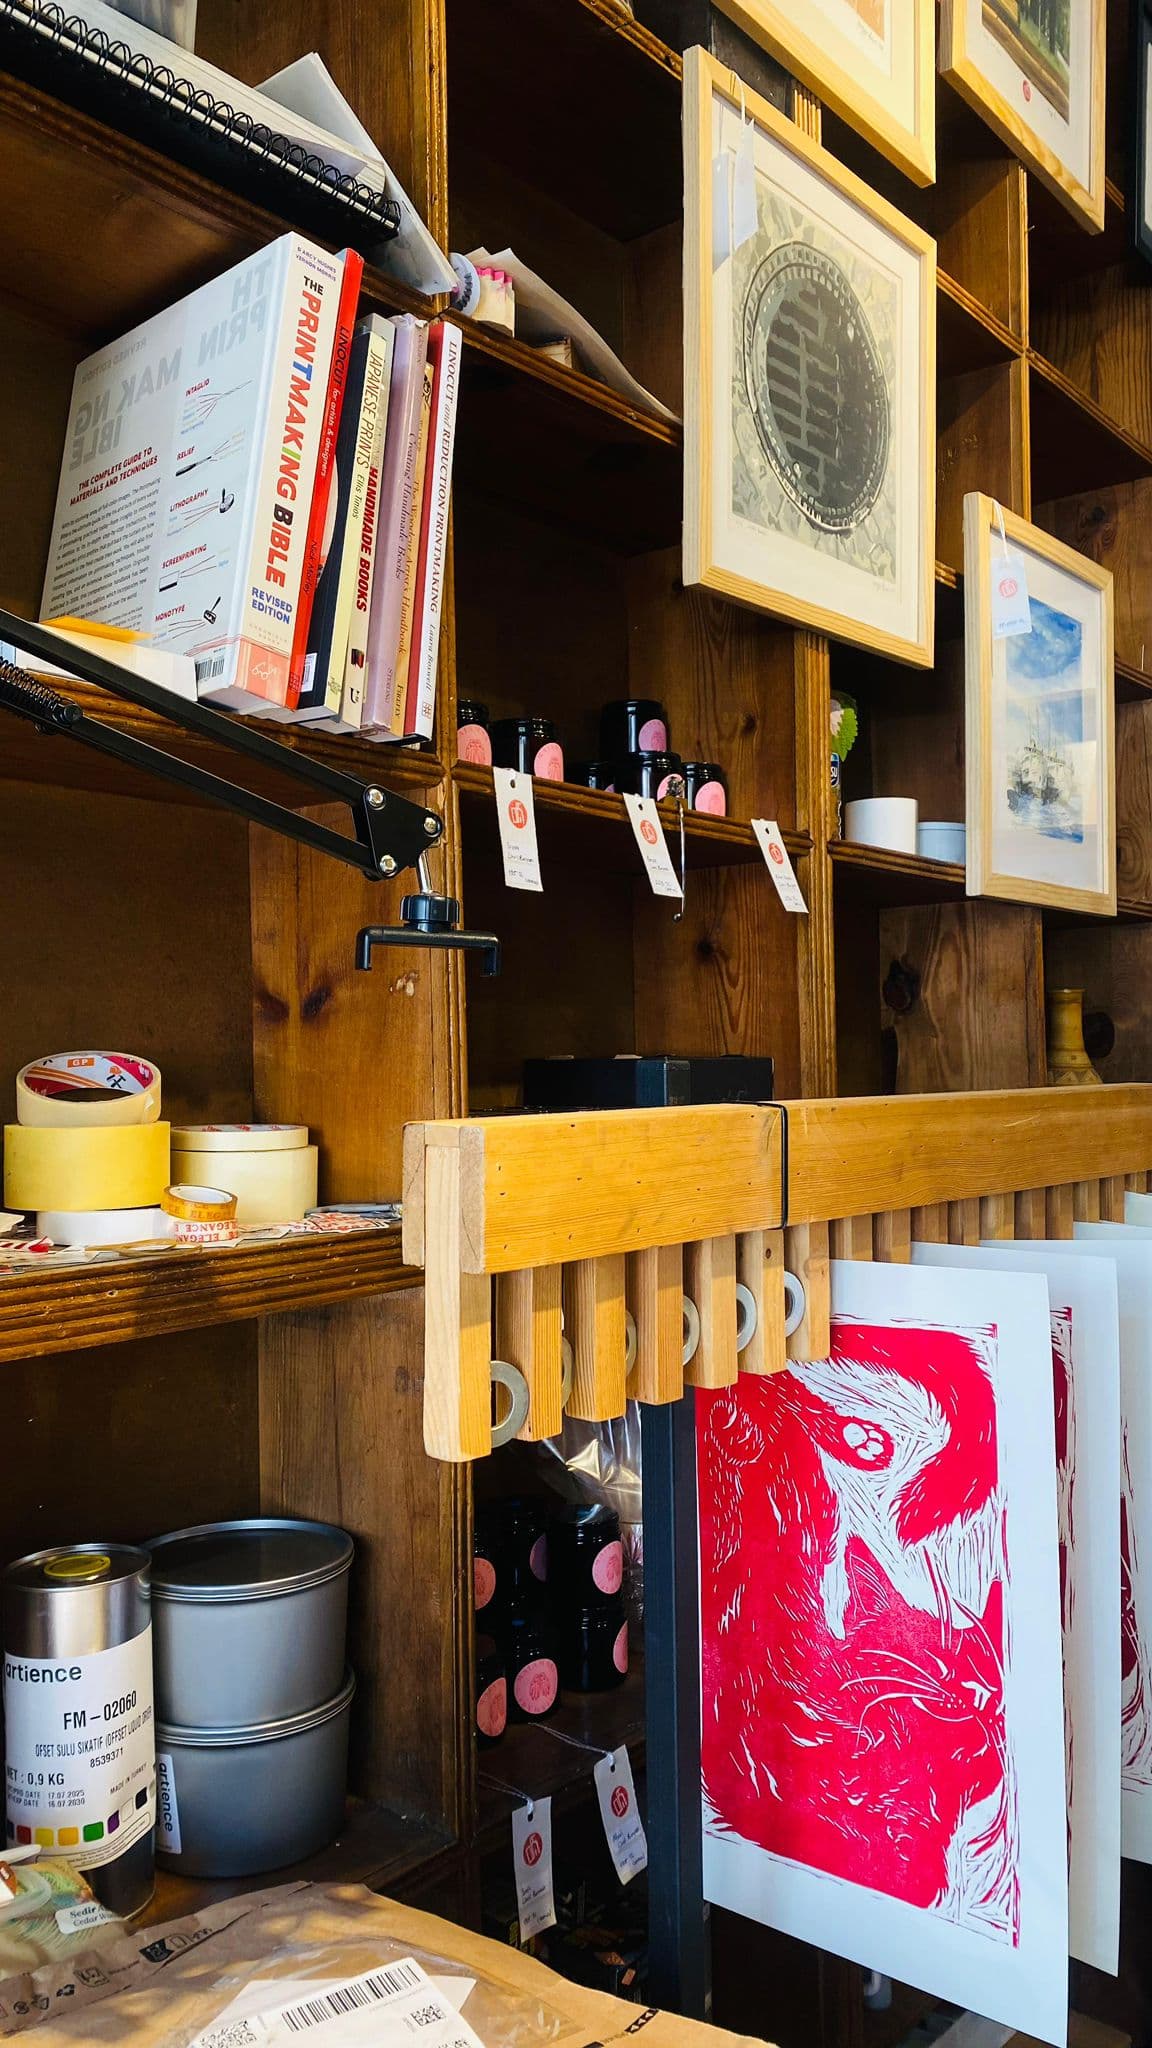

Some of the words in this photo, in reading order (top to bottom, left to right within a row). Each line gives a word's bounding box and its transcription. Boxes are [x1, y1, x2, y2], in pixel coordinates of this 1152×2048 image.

[303, 275, 324, 296] THE
[333, 325, 350, 387] LINOCUT
[445, 341, 457, 403] LINOCUT
[276, 290, 323, 502] PRINTMAKING
[363, 350, 384, 419] JAPANESE
[327, 402, 337, 426] artists
[443, 404, 453, 428] and
[320, 438, 333, 477] designers
[356, 418, 376, 469] PRINTS
[404, 432, 416, 479] Creating
[69, 482, 104, 507] MATERIALS
[104, 475, 119, 488] AND
[119, 455, 158, 481] TECHNIQUES
[79, 479, 89, 491] THE
[91, 462, 122, 485] COMPLETE
[123, 451, 142, 468] GUIDE
[143, 446, 152, 458] TO
[357, 474, 366, 493] Ellis
[437, 429, 451, 510] REDUCTION
[361, 466, 379, 556] HANDMADE
[399, 480, 413, 539] Handmade
[161, 543, 207, 569] SCREENPRINTING
[265, 503, 294, 589] BIBLE
[307, 539, 318, 561] Nick
[396, 541, 407, 579] Books
[429, 511, 445, 614] PRINTMAKING
[251, 586, 293, 613] REVISED
[356, 557, 371, 613] BOOKS
[154, 603, 186, 622] MONOTYPE
[251, 599, 291, 625] EDITION
[398, 595, 411, 655] Handbook
[427, 623, 436, 652] Laura
[425, 654, 434, 693] Boxwell
[72, 1058, 89, 1067] GP
[6, 1663, 82, 1683] artience
[35, 1743, 55, 1758] OFSET
[57, 1742, 76, 1757] SULU
[89, 1747, 124, 1769] 8539371
[27, 1772, 44, 1786] 0,9
[48, 1772, 65, 1786] KG
[159, 1761, 174, 1833] artience
[69, 1905, 97, 1919] Sedir
[72, 1915, 98, 1927] Cedar
